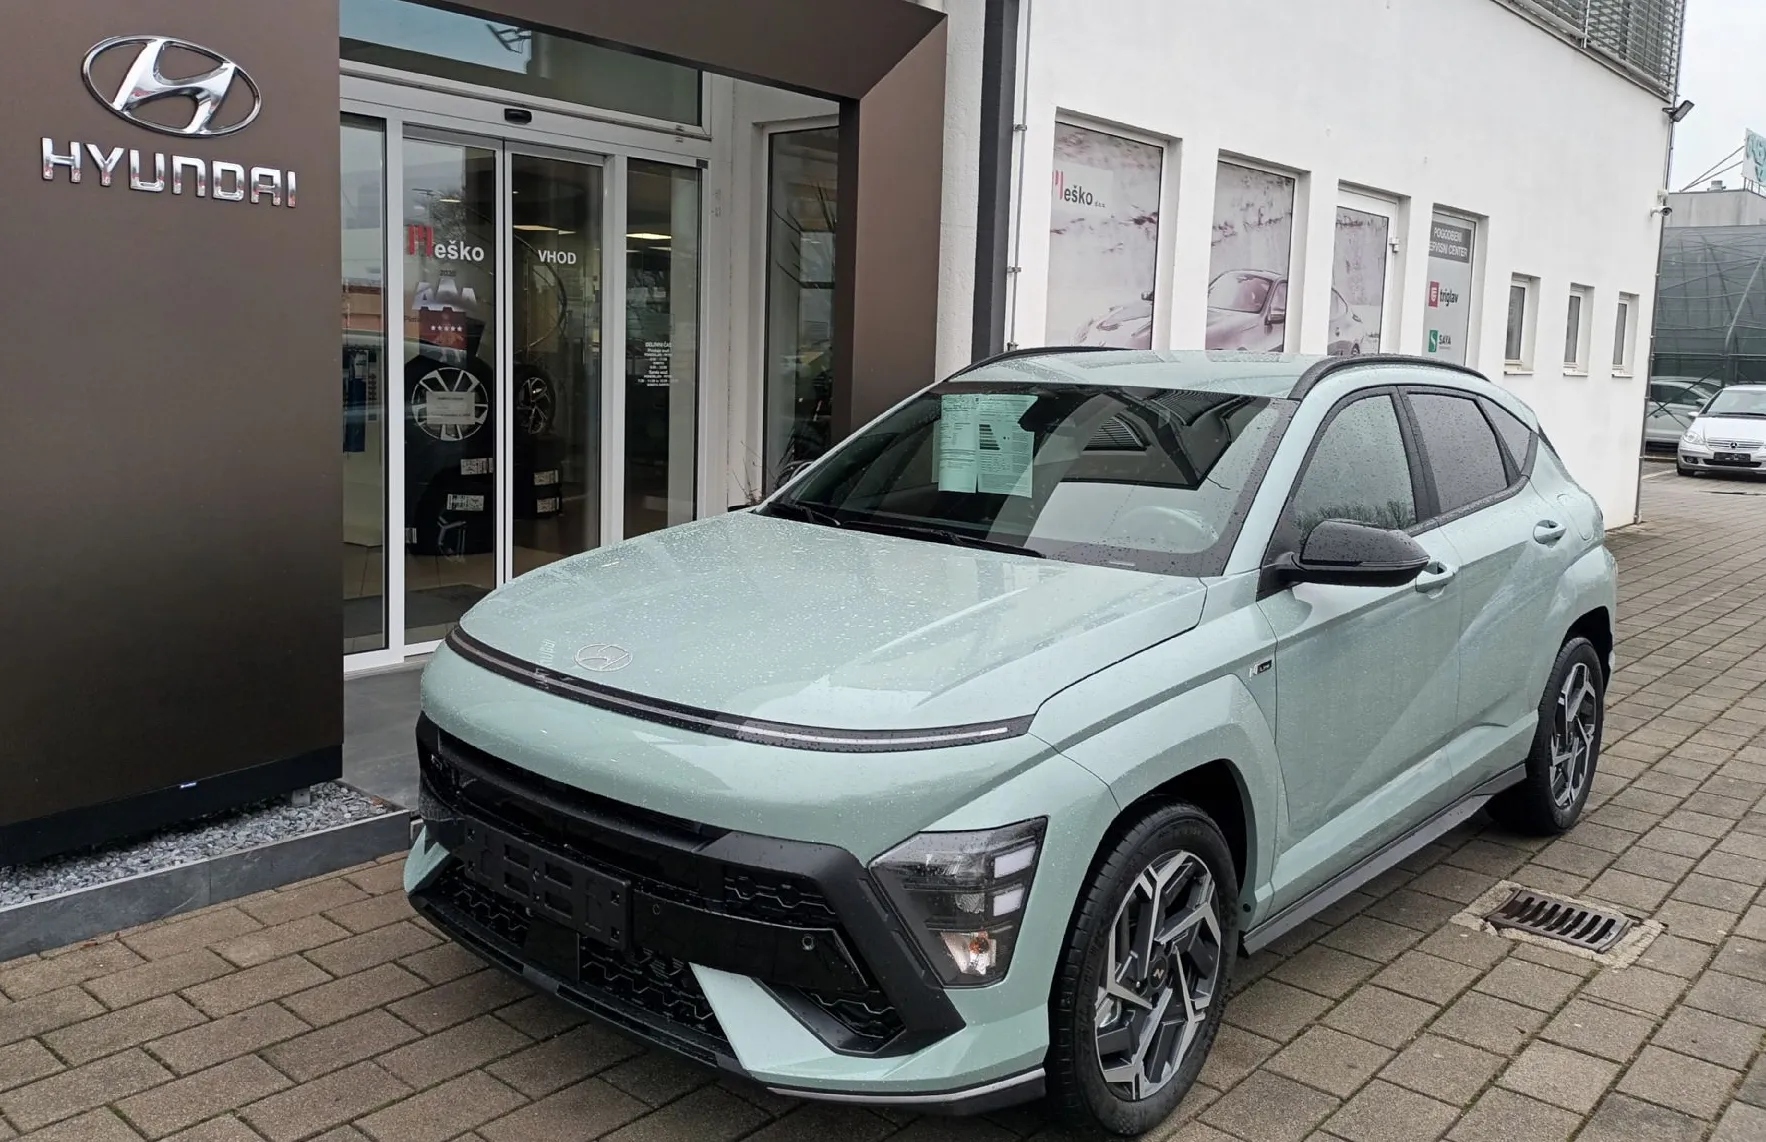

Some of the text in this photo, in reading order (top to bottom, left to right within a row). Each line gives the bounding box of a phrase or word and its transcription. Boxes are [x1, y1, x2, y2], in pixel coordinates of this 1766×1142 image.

[41, 137, 297, 208] HYUNDAI
[538, 249, 577, 265] VHOD
[1440, 288, 1459, 307] triglav
